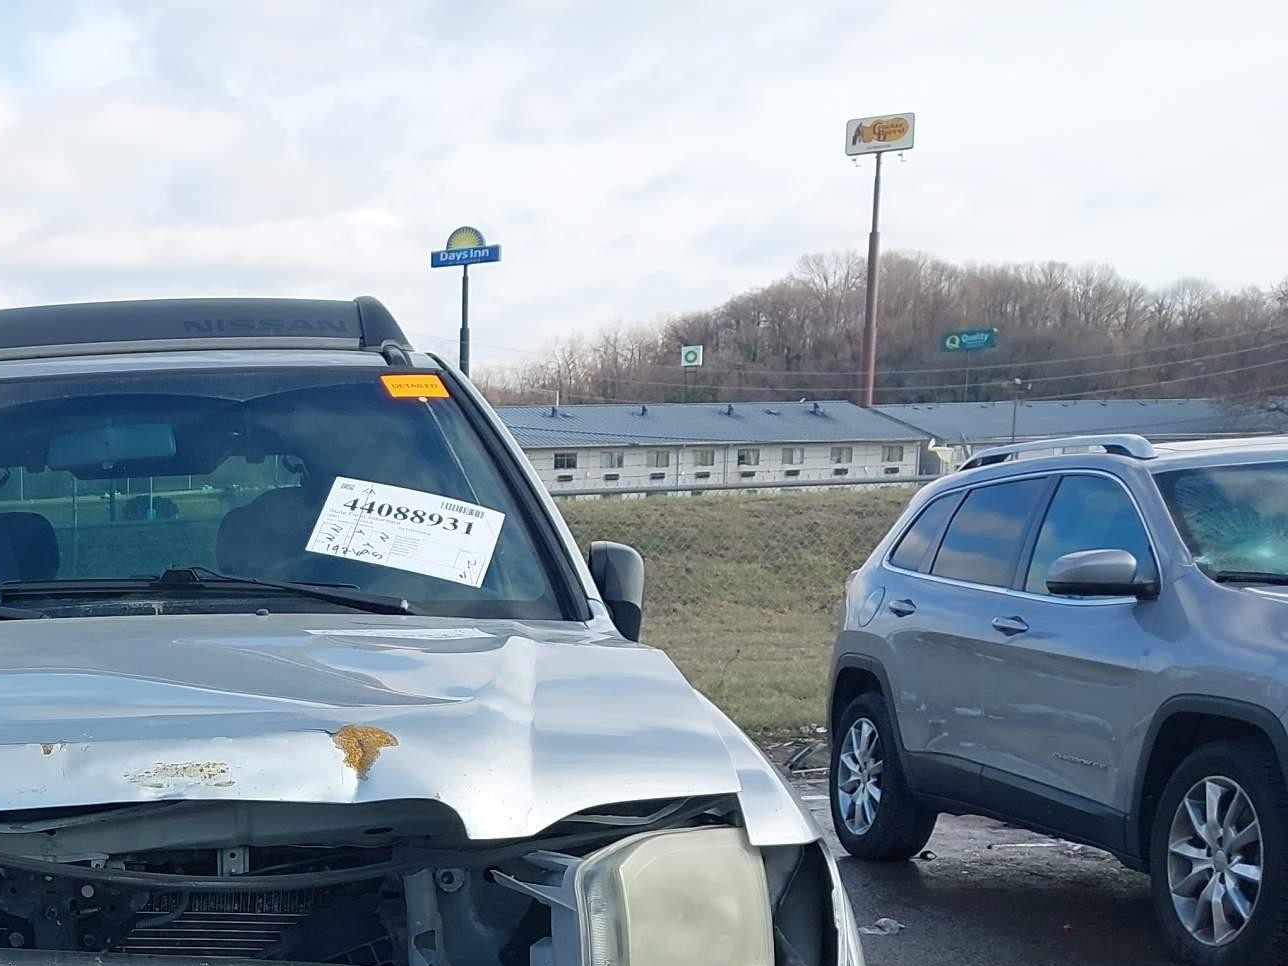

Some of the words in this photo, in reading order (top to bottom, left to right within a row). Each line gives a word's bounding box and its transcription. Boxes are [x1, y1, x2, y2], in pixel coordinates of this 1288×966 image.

[440, 250, 469, 261] Days
[469, 248, 490, 258] Inn
[183, 319, 347, 333] NISSAN
[961, 332, 990, 343] Quality
[342, 497, 475, 537] 44088931
